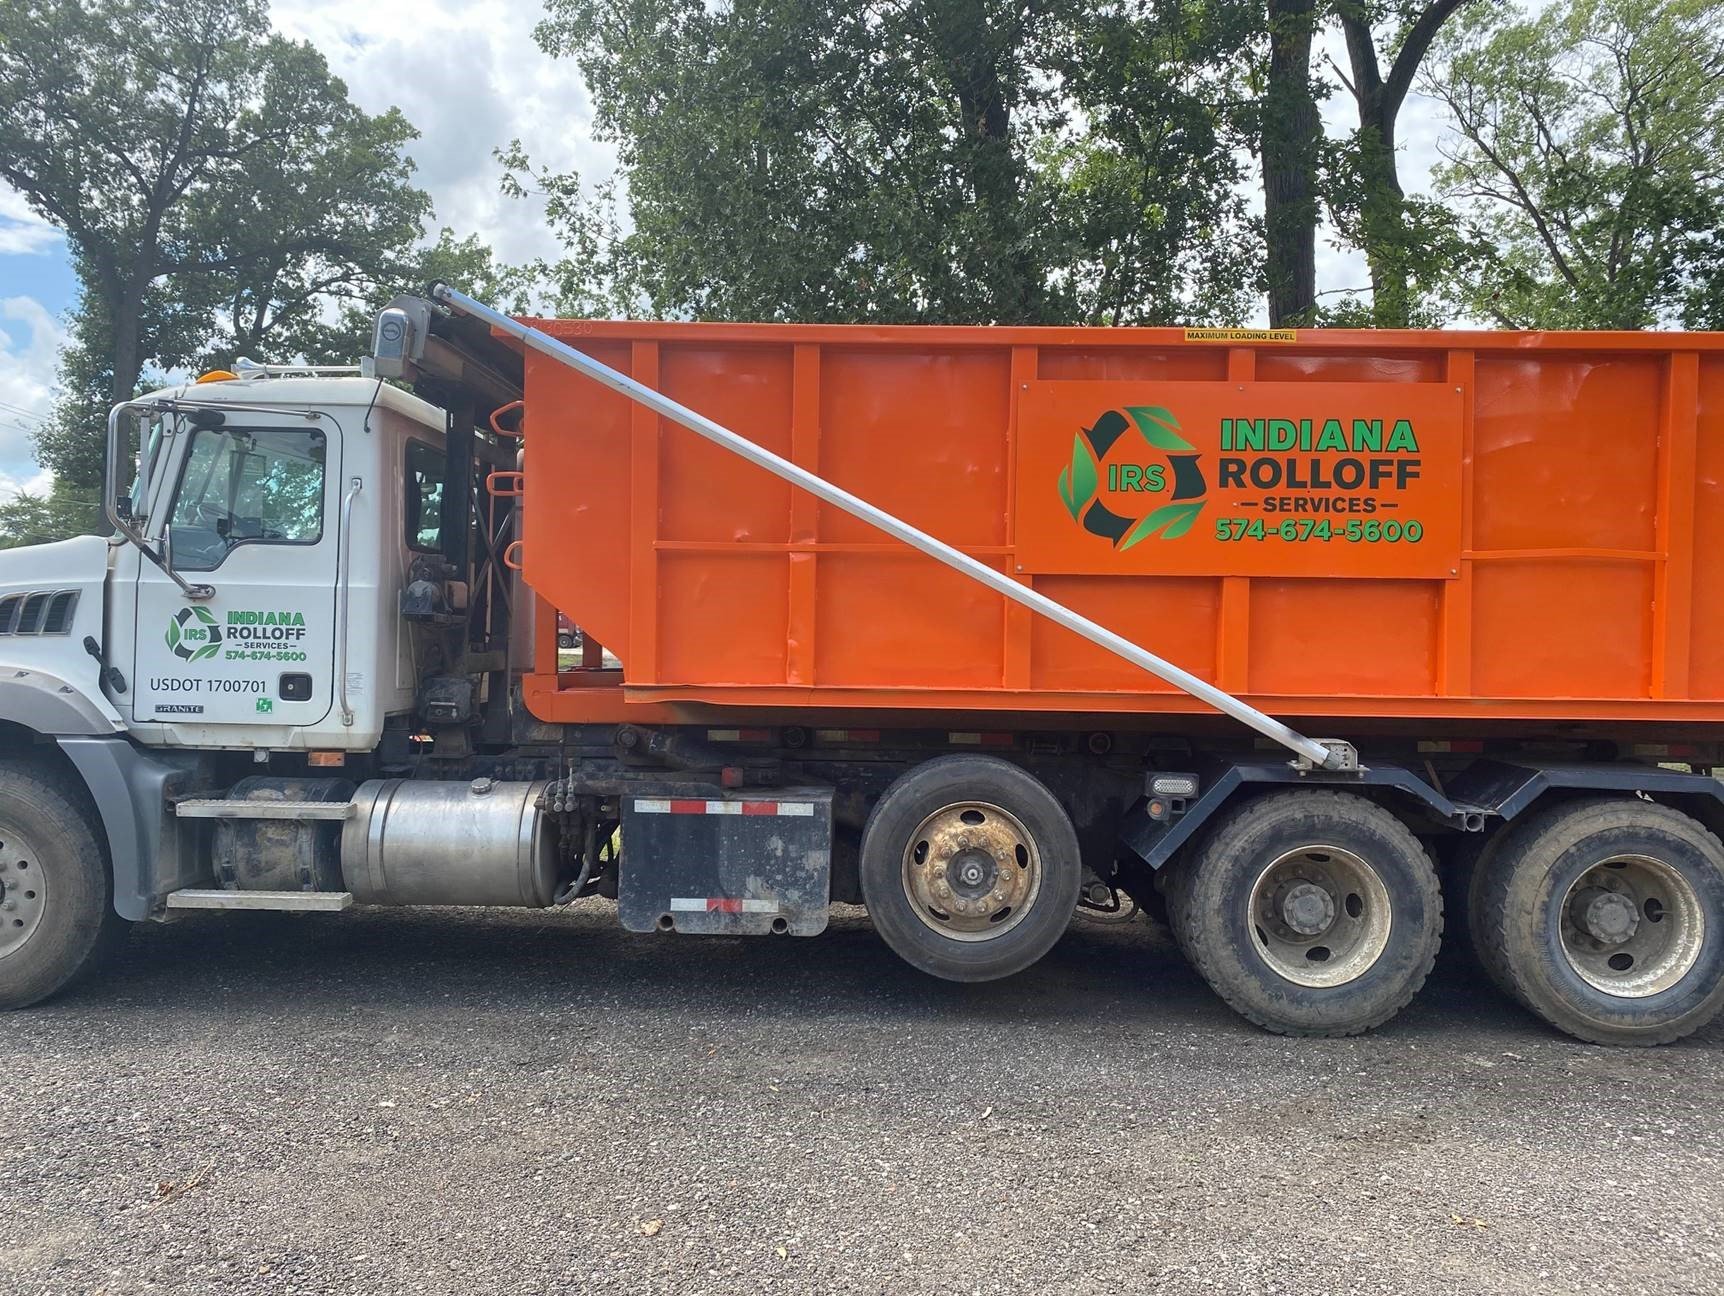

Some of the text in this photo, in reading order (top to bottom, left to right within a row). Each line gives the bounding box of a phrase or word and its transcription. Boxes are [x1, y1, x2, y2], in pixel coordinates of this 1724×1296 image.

[1220, 418, 1420, 453] INDIANA
[1108, 464, 1166, 492] IRS
[1218, 457, 1421, 490] ROLLOFF
[1262, 497, 1377, 513] SERVICES
[1215, 519, 1424, 543] 574-674-5600
[227, 611, 305, 626] INDIANA
[184, 629, 207, 640] IRS
[226, 627, 306, 640] ROLLOFF
[225, 650, 307, 662] 574-674-5600
[150, 678, 266, 693] USDOT 1700701
